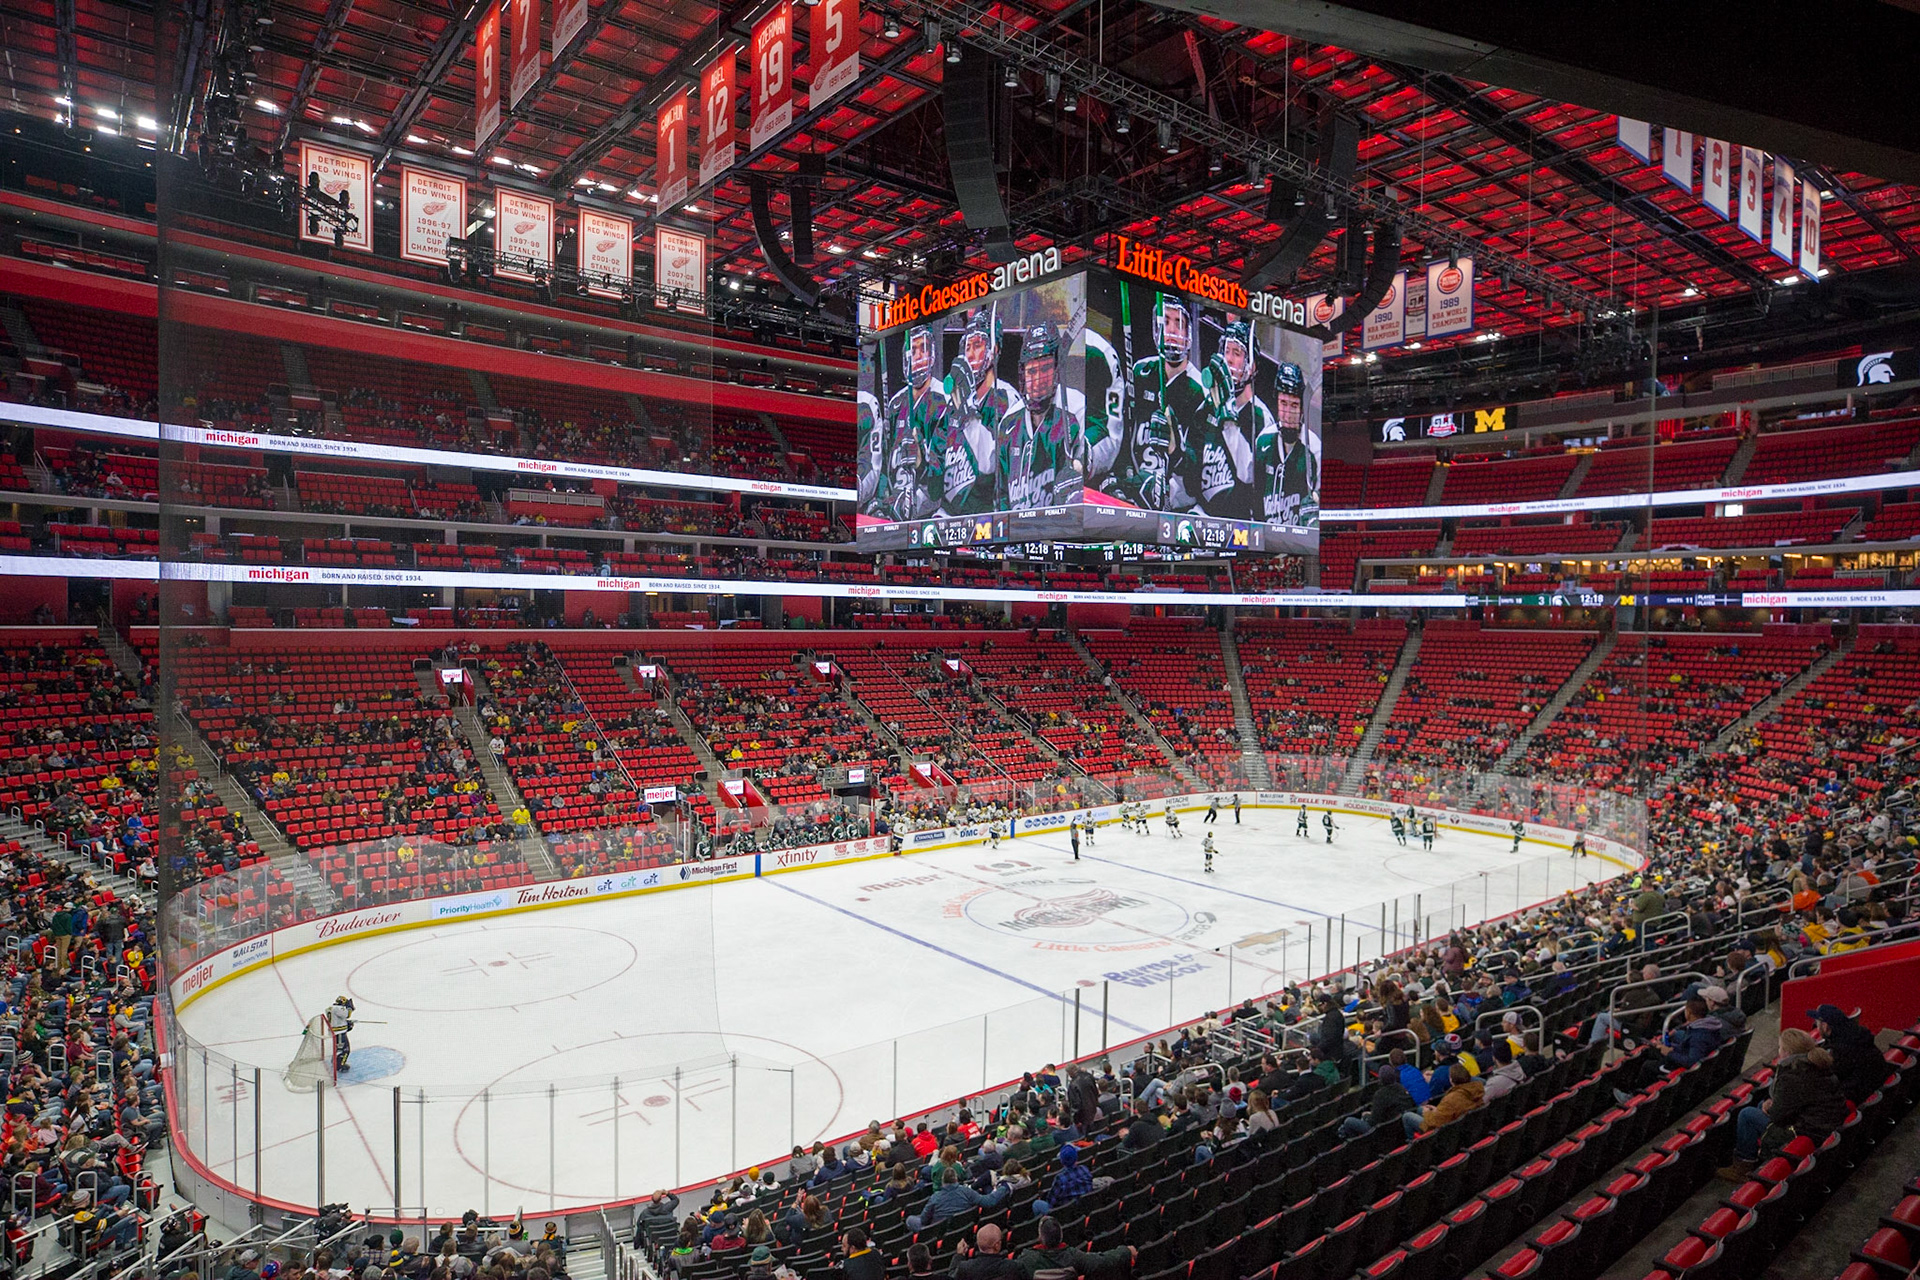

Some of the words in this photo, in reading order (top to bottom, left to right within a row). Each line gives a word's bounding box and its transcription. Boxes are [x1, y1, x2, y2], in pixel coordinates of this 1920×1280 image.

[825, 0, 843, 54] 5
[757, 17, 786, 53] YZERMAN
[483, 44, 493, 99] 9
[759, 40, 784, 106] 19
[707, 86, 729, 145] 12
[668, 128, 676, 174] 1
[318, 155, 356, 170] DETROIT
[1712, 141, 1723, 188] 2
[312, 163, 329, 174] RED
[333, 169, 362, 181] WINGS
[417, 179, 452, 191] DETROIT
[1746, 169, 1757, 212] 3
[411, 186, 428, 195] RED
[430, 191, 457, 202] WINGS
[509, 199, 541, 212] DETROIT
[504, 206, 520, 215] RED
[521, 210, 546, 222] WINGS
[1778, 196, 1787, 236] 4
[417, 217, 451, 230] 1996-97
[591, 219, 621, 231] DETROIT
[416, 226, 452, 238] STANLEY
[587, 226, 602, 235] RED
[603, 230, 626, 240] WINGS
[1804, 214, 1816, 256] 10
[426, 238, 443, 246] CUP
[667, 236, 694, 248] DETROIT
[508, 244, 541, 257] STANLEY
[663, 243, 677, 251] RED
[677, 246, 699, 257] WINGS
[591, 254, 620, 265] 2001-02
[590, 262, 621, 274] STANLEY
[1116, 235, 1173, 286] Little
[1174, 256, 1249, 309] Caesars
[1251, 290, 1305, 326] arena
[877, 292, 920, 332] Little
[920, 272, 989, 316] Caesars
[992, 246, 1062, 291] arena
[1439, 297, 1460, 310] 1989
[1374, 312, 1393, 323] 1990
[1446, 307, 1468, 319] WORLD
[1379, 321, 1400, 333] WORLD
[1432, 316, 1468, 330] CHAMPIONS
[1367, 329, 1400, 343] CHAMPIONS
[1474, 407, 1506, 433] M
[206, 431, 258, 445] michigan
[269, 439, 285, 447] BORN
[517, 460, 557, 473] michigan
[751, 481, 782, 493] michigan
[1721, 488, 1763, 498] michigan
[1044, 508, 1066, 516] PENALTY
[1096, 507, 1115, 516] PLAYER
[1125, 510, 1147, 518] PENALTY
[1488, 505, 1520, 514] michigan
[967, 519, 974, 527] 11
[997, 521, 1004, 538] 1
[945, 528, 967, 541] 12:18
[975, 522, 992, 540] M
[1162, 522, 1171, 538] 3
[1202, 528, 1225, 542] 12:18
[911, 530, 918, 545] 3
[1233, 529, 1248, 546] M
[1254, 531, 1259, 546] 1
[1025, 542, 1049, 554] 12:18
[1119, 543, 1143, 555] 12:18
[1054, 551, 1064, 560] 11
[1104, 551, 1113, 560] 18
[249, 567, 309, 581] michigan
[357, 573, 383, 581] RAISED.
[597, 578, 640, 590] michigan
[848, 586, 880, 597] michigan
[1037, 592, 1068, 602] michigan
[1241, 595, 1276, 605] michigan
[1538, 596, 1545, 605] 3
[1580, 594, 1604, 603] 12:18
[1620, 595, 1635, 606] M
[1643, 596, 1649, 606] 1
[1743, 594, 1787, 606] michigan
[646, 788, 674, 800] meijer
[1166, 797, 1189, 805] HITACHI
[1297, 797, 1320, 805] BELLE
[1343, 802, 1368, 811] HOLIDAY
[960, 827, 979, 838] DMC
[1528, 827, 1544, 836] Little
[1544, 831, 1565, 840] Caesars
[777, 850, 818, 867] xfinity
[691, 864, 722, 875] Michigan
[722, 861, 737, 872] First
[597, 879, 613, 892] GFL
[643, 872, 658, 886] GFL
[860, 873, 947, 892] meijer
[517, 887, 541, 905] Tim
[439, 899, 494, 915] PriorityHealth
[316, 911, 402, 939] Budweiser
[250, 938, 268, 953] STAR
[1032, 941, 1088, 953] Little
[1093, 940, 1172, 953] Caesars
[1102, 959, 1173, 982] Burns
[1175, 953, 1201, 964] &
[182, 965, 214, 995] meijer
[1124, 962, 1213, 988] Wilcox
